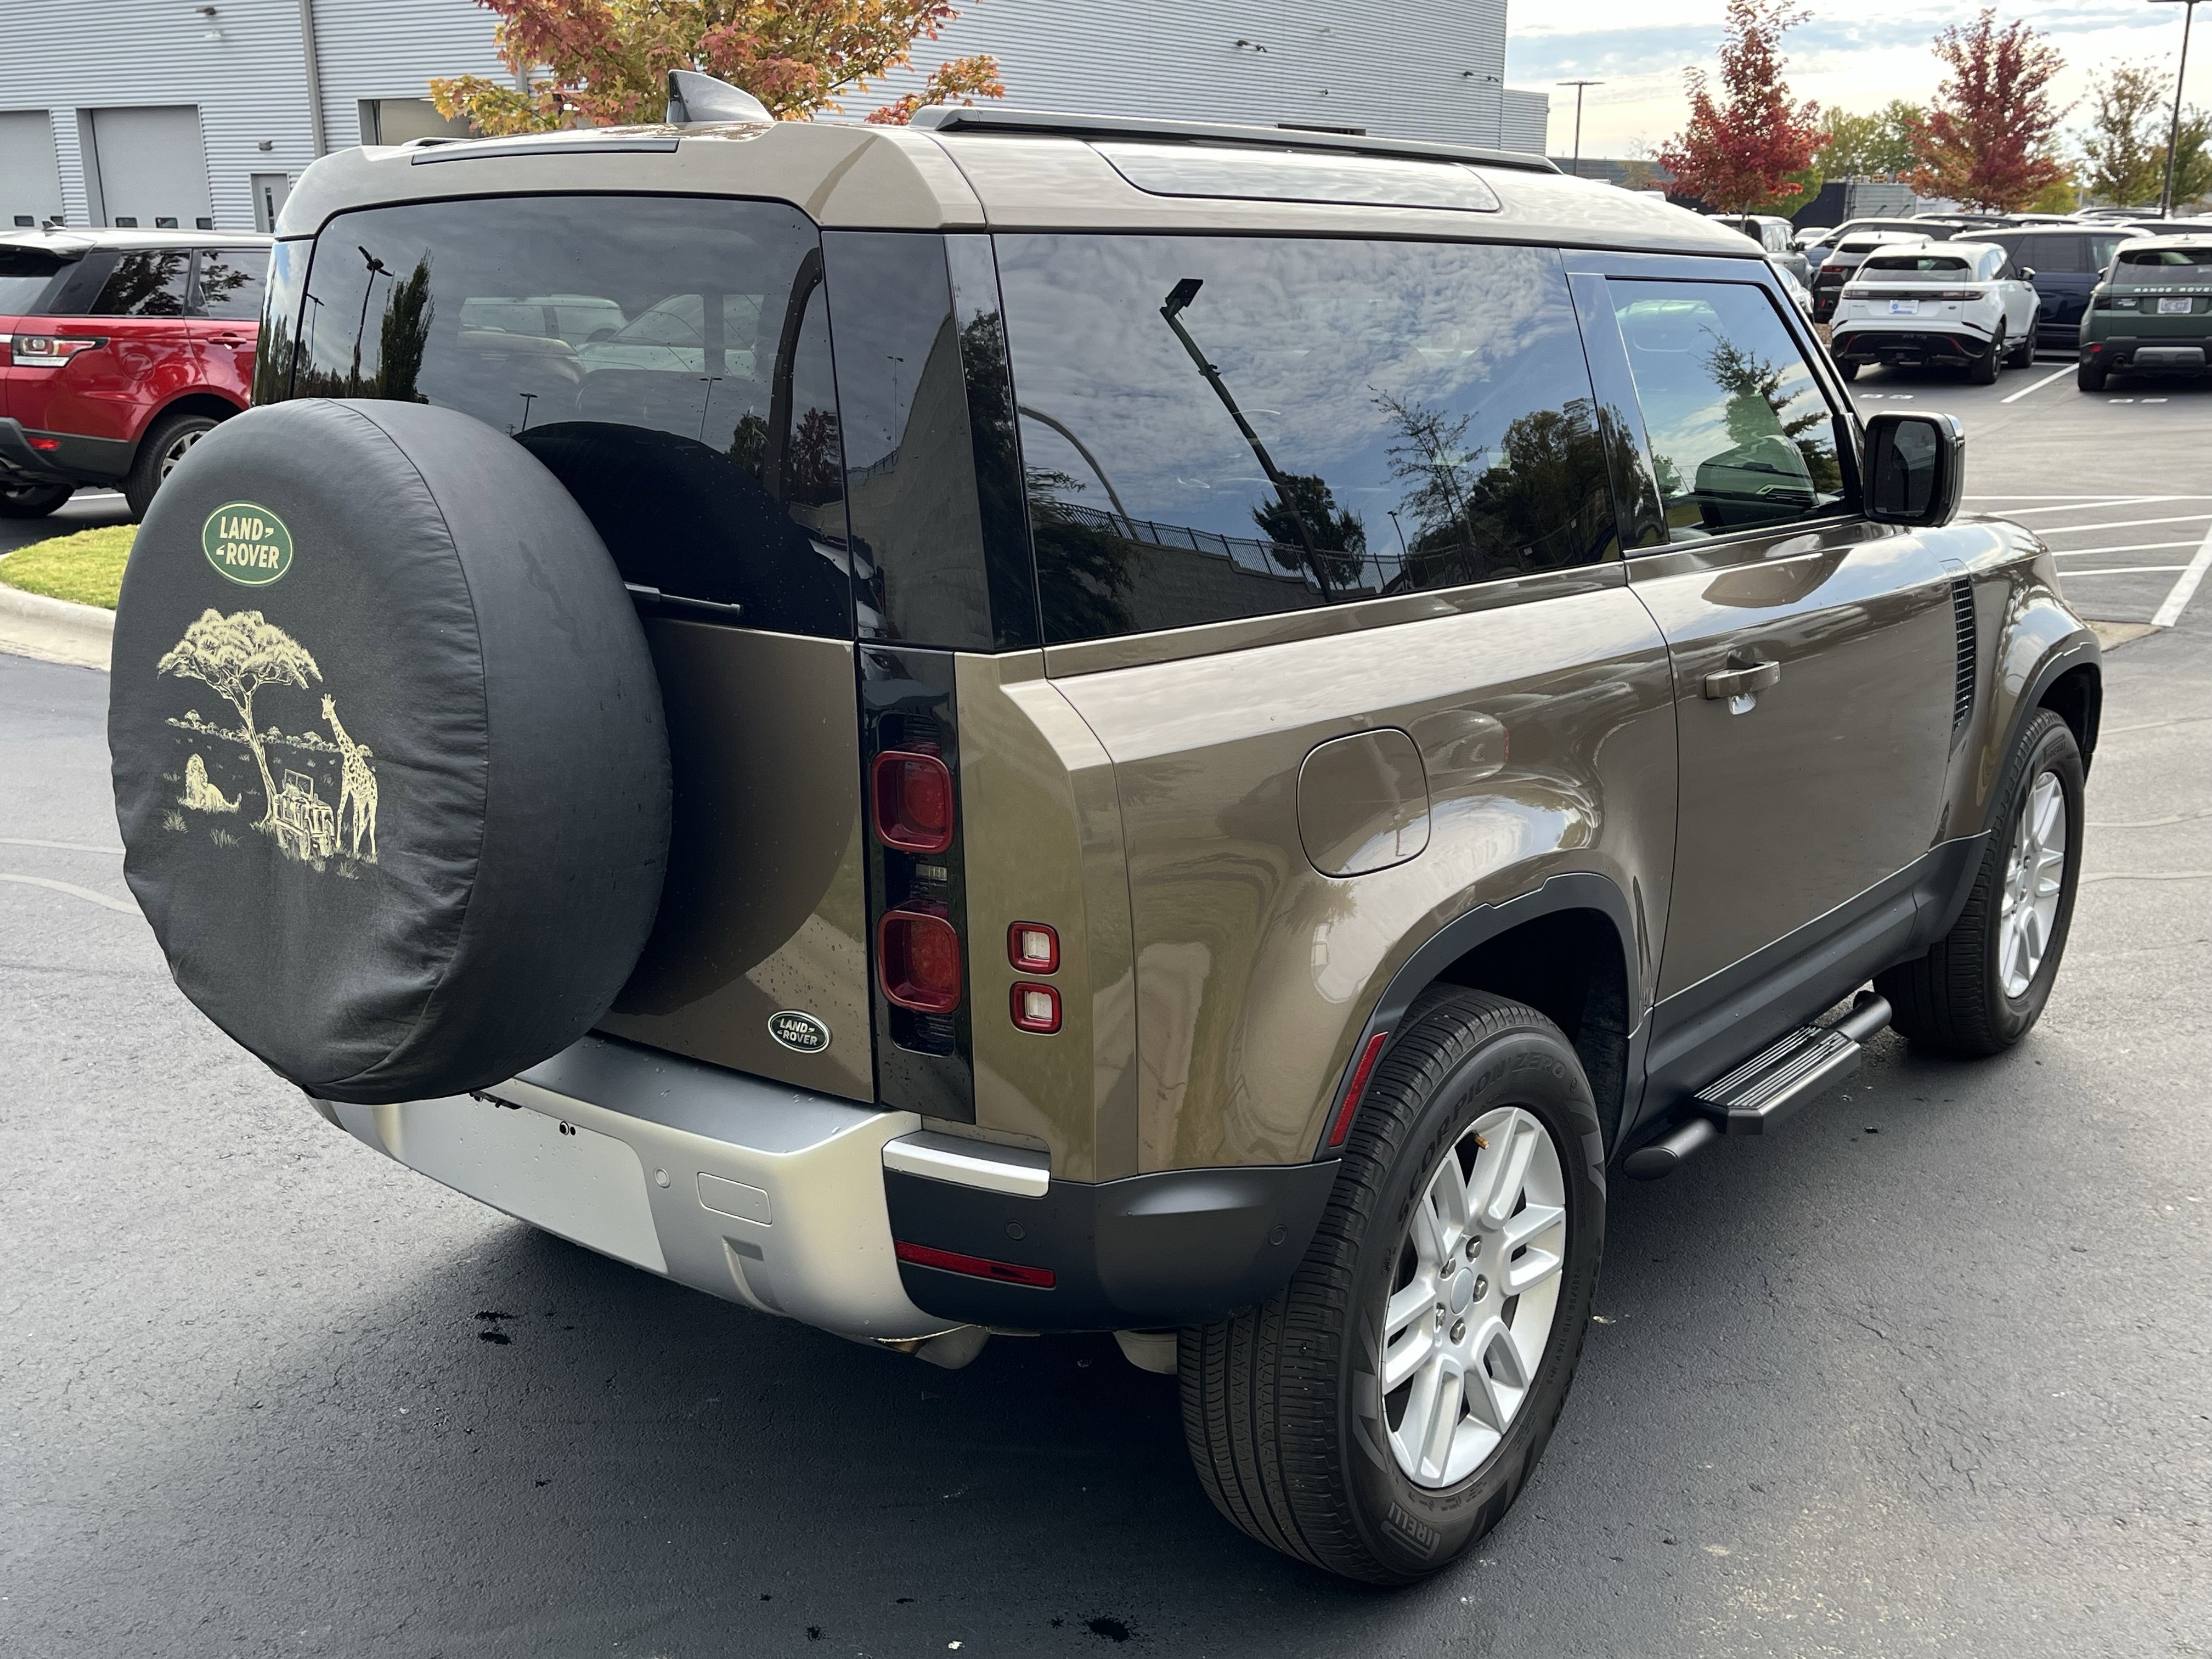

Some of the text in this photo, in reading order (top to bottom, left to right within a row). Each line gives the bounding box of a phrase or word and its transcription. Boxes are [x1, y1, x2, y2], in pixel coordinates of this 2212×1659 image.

[220, 516, 263, 540] LAND
[225, 543, 279, 569] ROVER
[780, 1018, 808, 1033] LAND
[782, 1030, 817, 1046] ROVER
[1398, 1058, 1510, 1223] SCORPION
[1512, 1052, 1566, 1079] ZERO
[1381, 1500, 1441, 1560] PIRELLI
